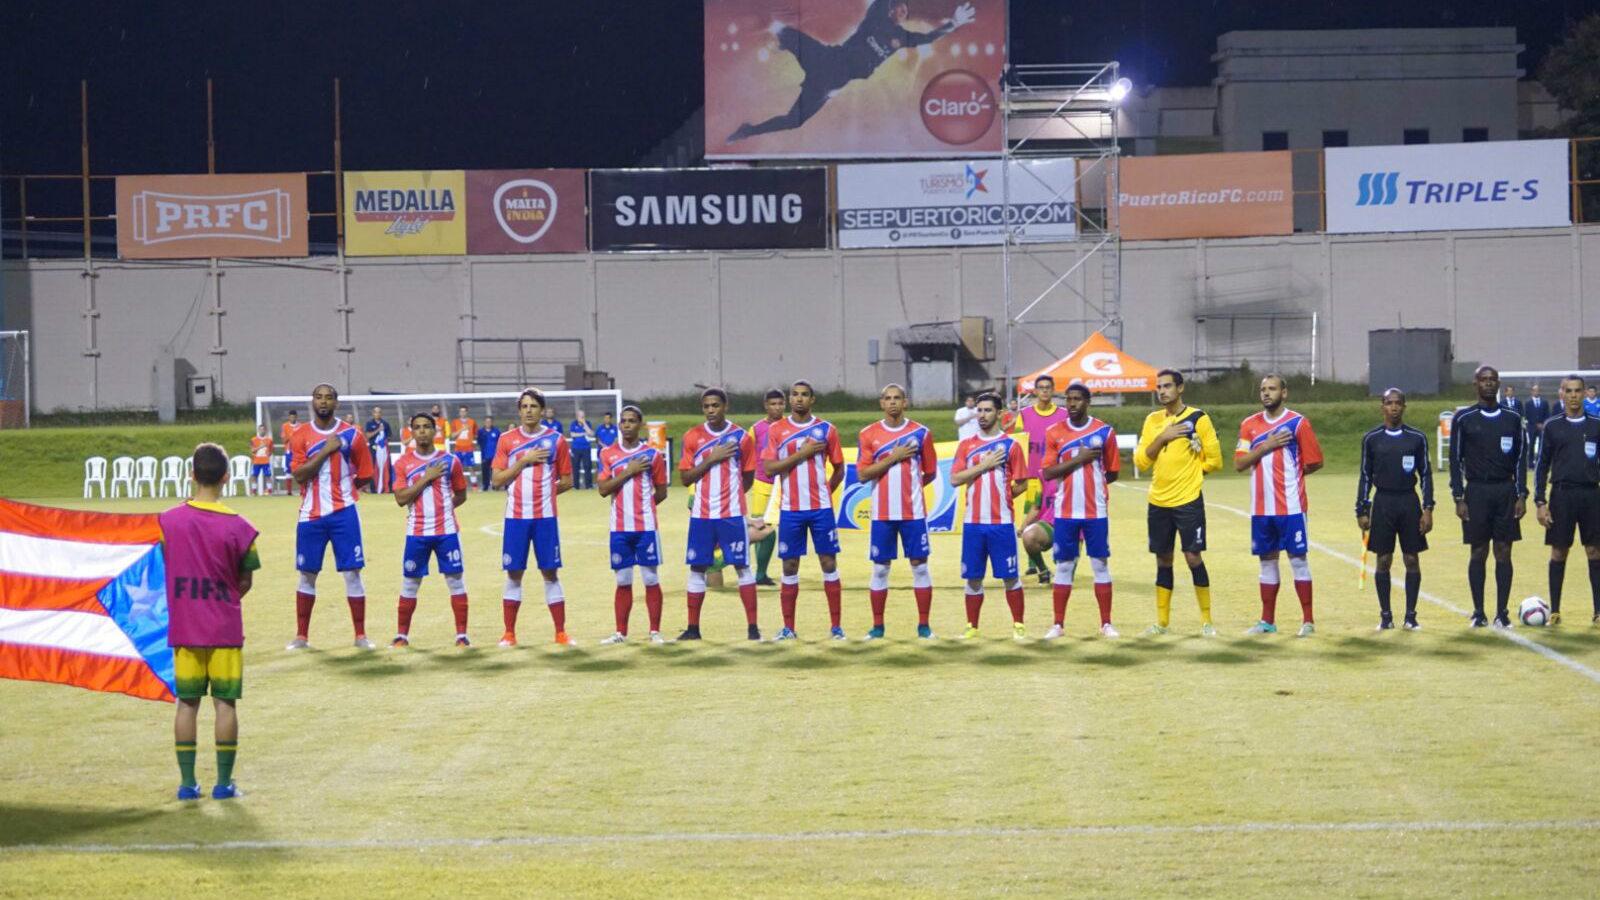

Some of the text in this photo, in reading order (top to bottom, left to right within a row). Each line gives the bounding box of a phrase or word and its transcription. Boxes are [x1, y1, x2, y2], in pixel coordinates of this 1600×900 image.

[925, 98, 981, 116] Claro
[1118, 188, 1284, 207] PuertoRicoFC.com
[1405, 180, 1539, 204] TRIPLE-S
[356, 189, 454, 211] MEDALLA
[505, 198, 546, 209] MALTA
[615, 193, 802, 226] SAMSUNG
[843, 204, 1072, 228] SEEPUERTORICO.COM
[156, 200, 268, 233] PRFC
[1087, 378, 1148, 389] GATORADE
[1196, 526, 1202, 539] 1
[921, 533, 928, 546] 5
[354, 545, 361, 558] 9
[647, 541, 655, 554] 4
[730, 541, 745, 553] 18
[446, 549, 461, 562] 10
